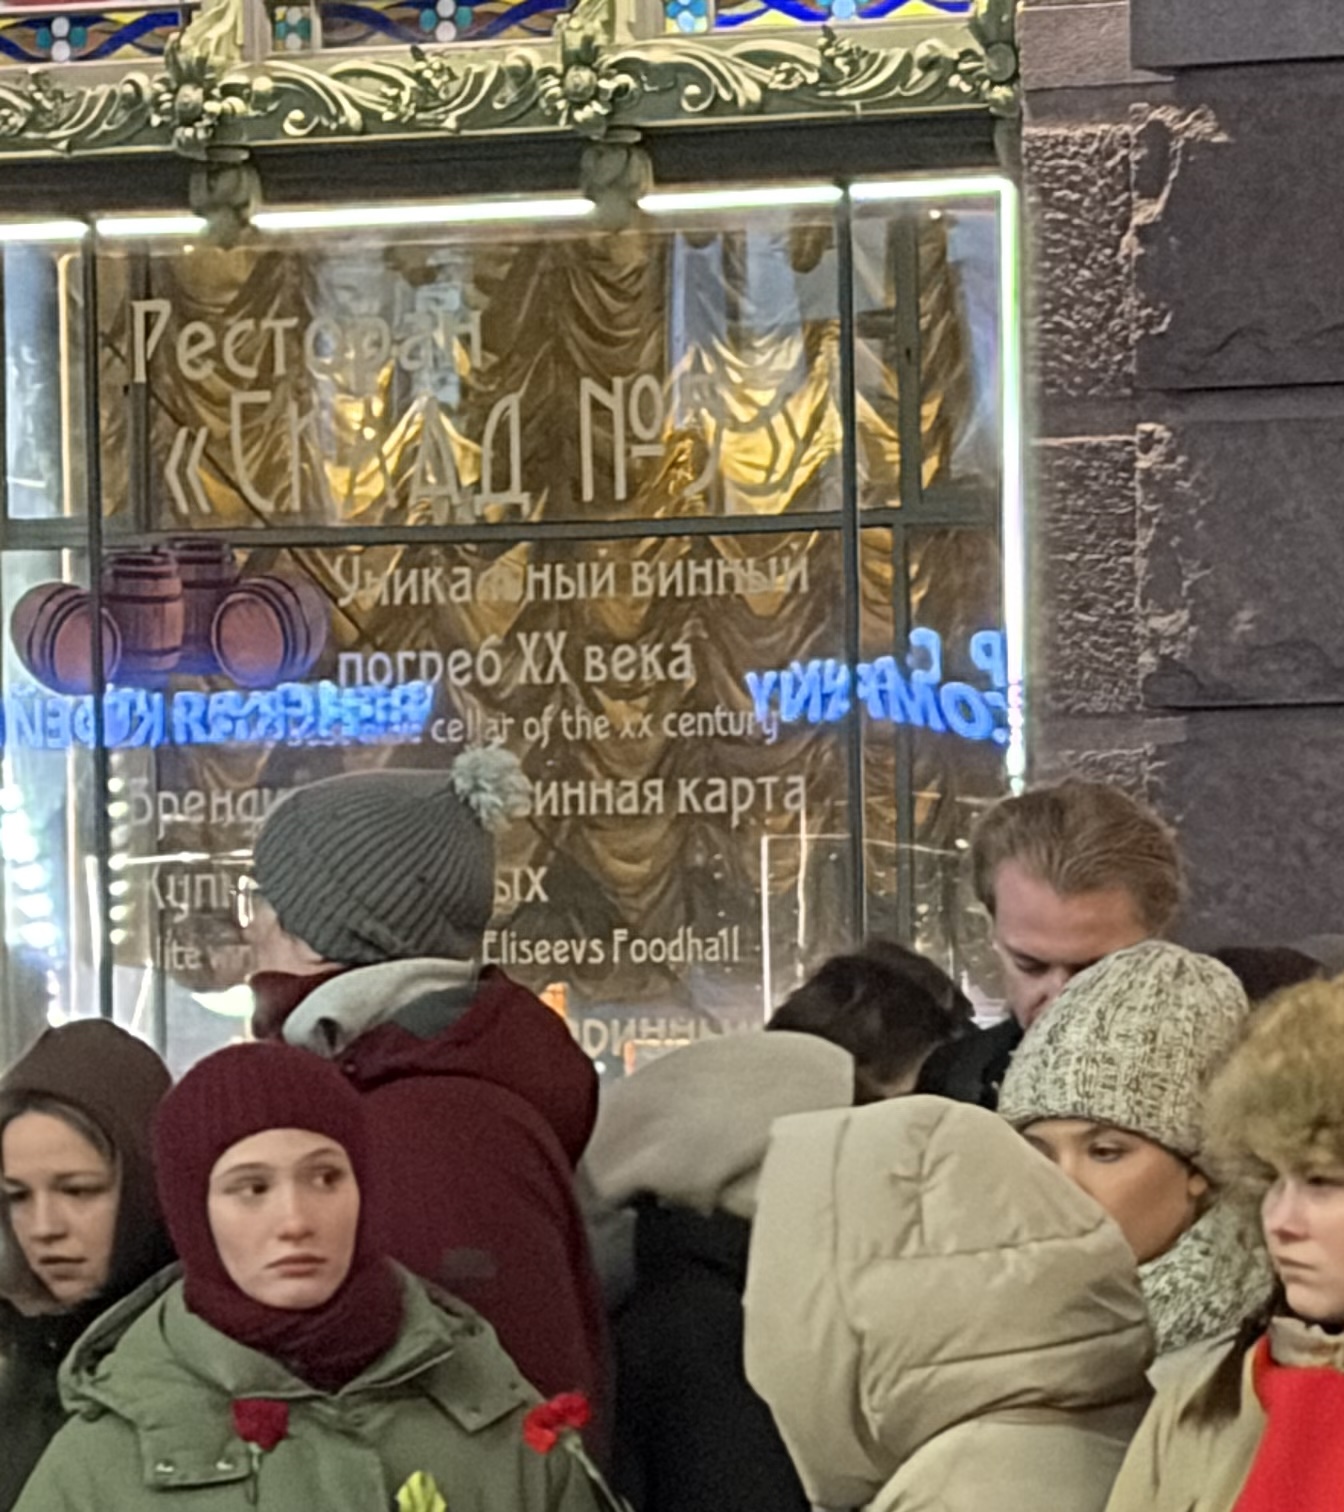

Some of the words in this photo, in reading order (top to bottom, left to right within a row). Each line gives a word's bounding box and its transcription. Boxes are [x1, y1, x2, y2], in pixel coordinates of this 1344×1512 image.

[132, 299, 483, 383] Ресторан
[631, 545, 810, 598] винный
[337, 634, 502, 690] погреб
[583, 642, 696, 684] века
[431, 707, 514, 742] cellar
[522, 702, 557, 748] of
[562, 703, 611, 738] the
[662, 704, 780, 745] century
[510, 777, 665, 818] инная
[677, 775, 807, 829] карта
[481, 925, 605, 966] Eliseevs
[612, 923, 741, 964] Foodhall
